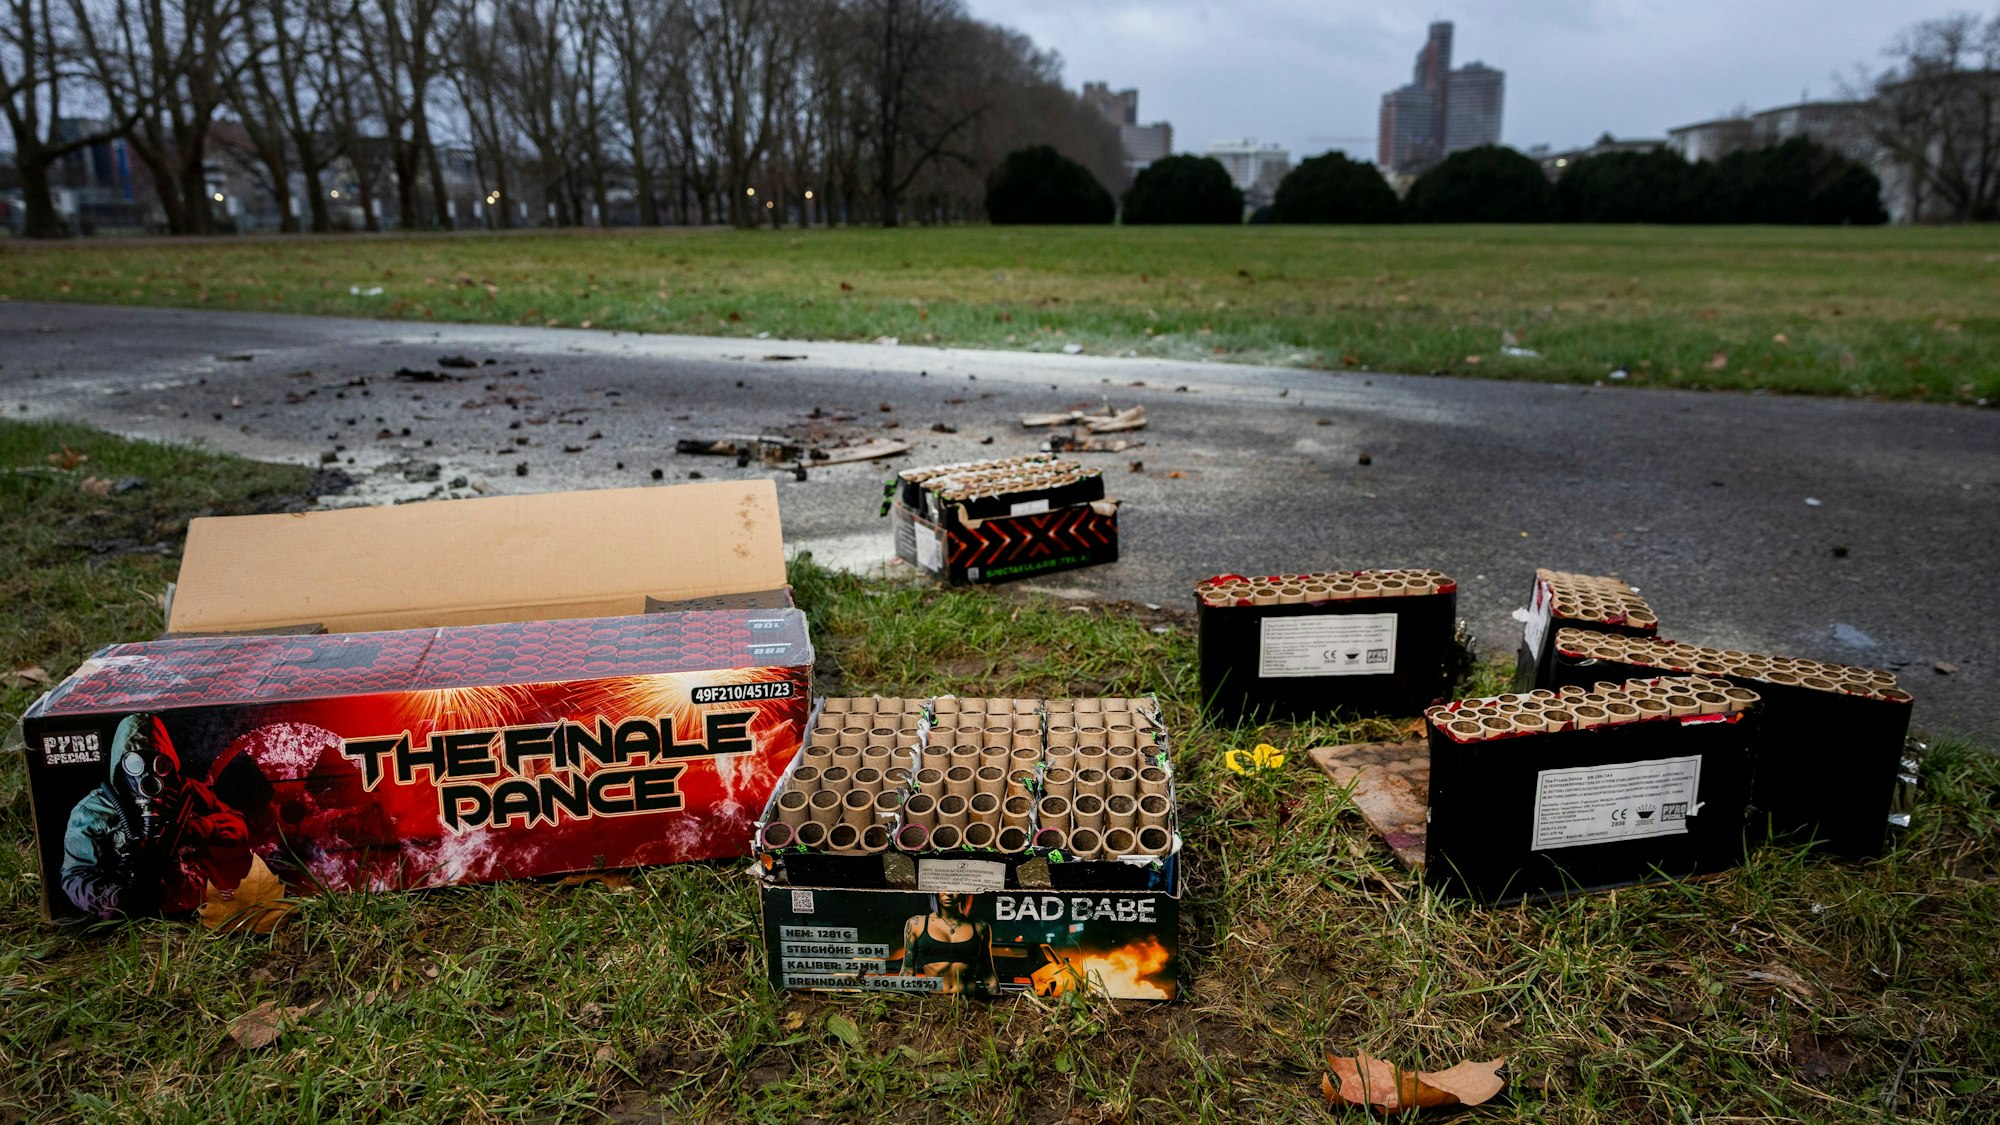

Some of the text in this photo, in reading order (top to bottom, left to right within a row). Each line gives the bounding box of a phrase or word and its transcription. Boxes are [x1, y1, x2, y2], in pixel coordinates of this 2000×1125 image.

[695, 683, 790, 702] 49F210/451/23
[43, 734, 99, 755] PYRO
[342, 708, 759, 791] THE FINALE
[46, 751, 100, 765] SPECIALS
[439, 762, 687, 835] DANCE
[1663, 805, 1687, 815] PYRO
[996, 896, 1157, 923] BAD BABE
[786, 930, 814, 938] NEM:
[817, 930, 842, 938] 1281
[786, 944, 854, 954] STEIGHÖHE:
[857, 947, 873, 955] 50
[788, 961, 842, 970] KALIBER:
